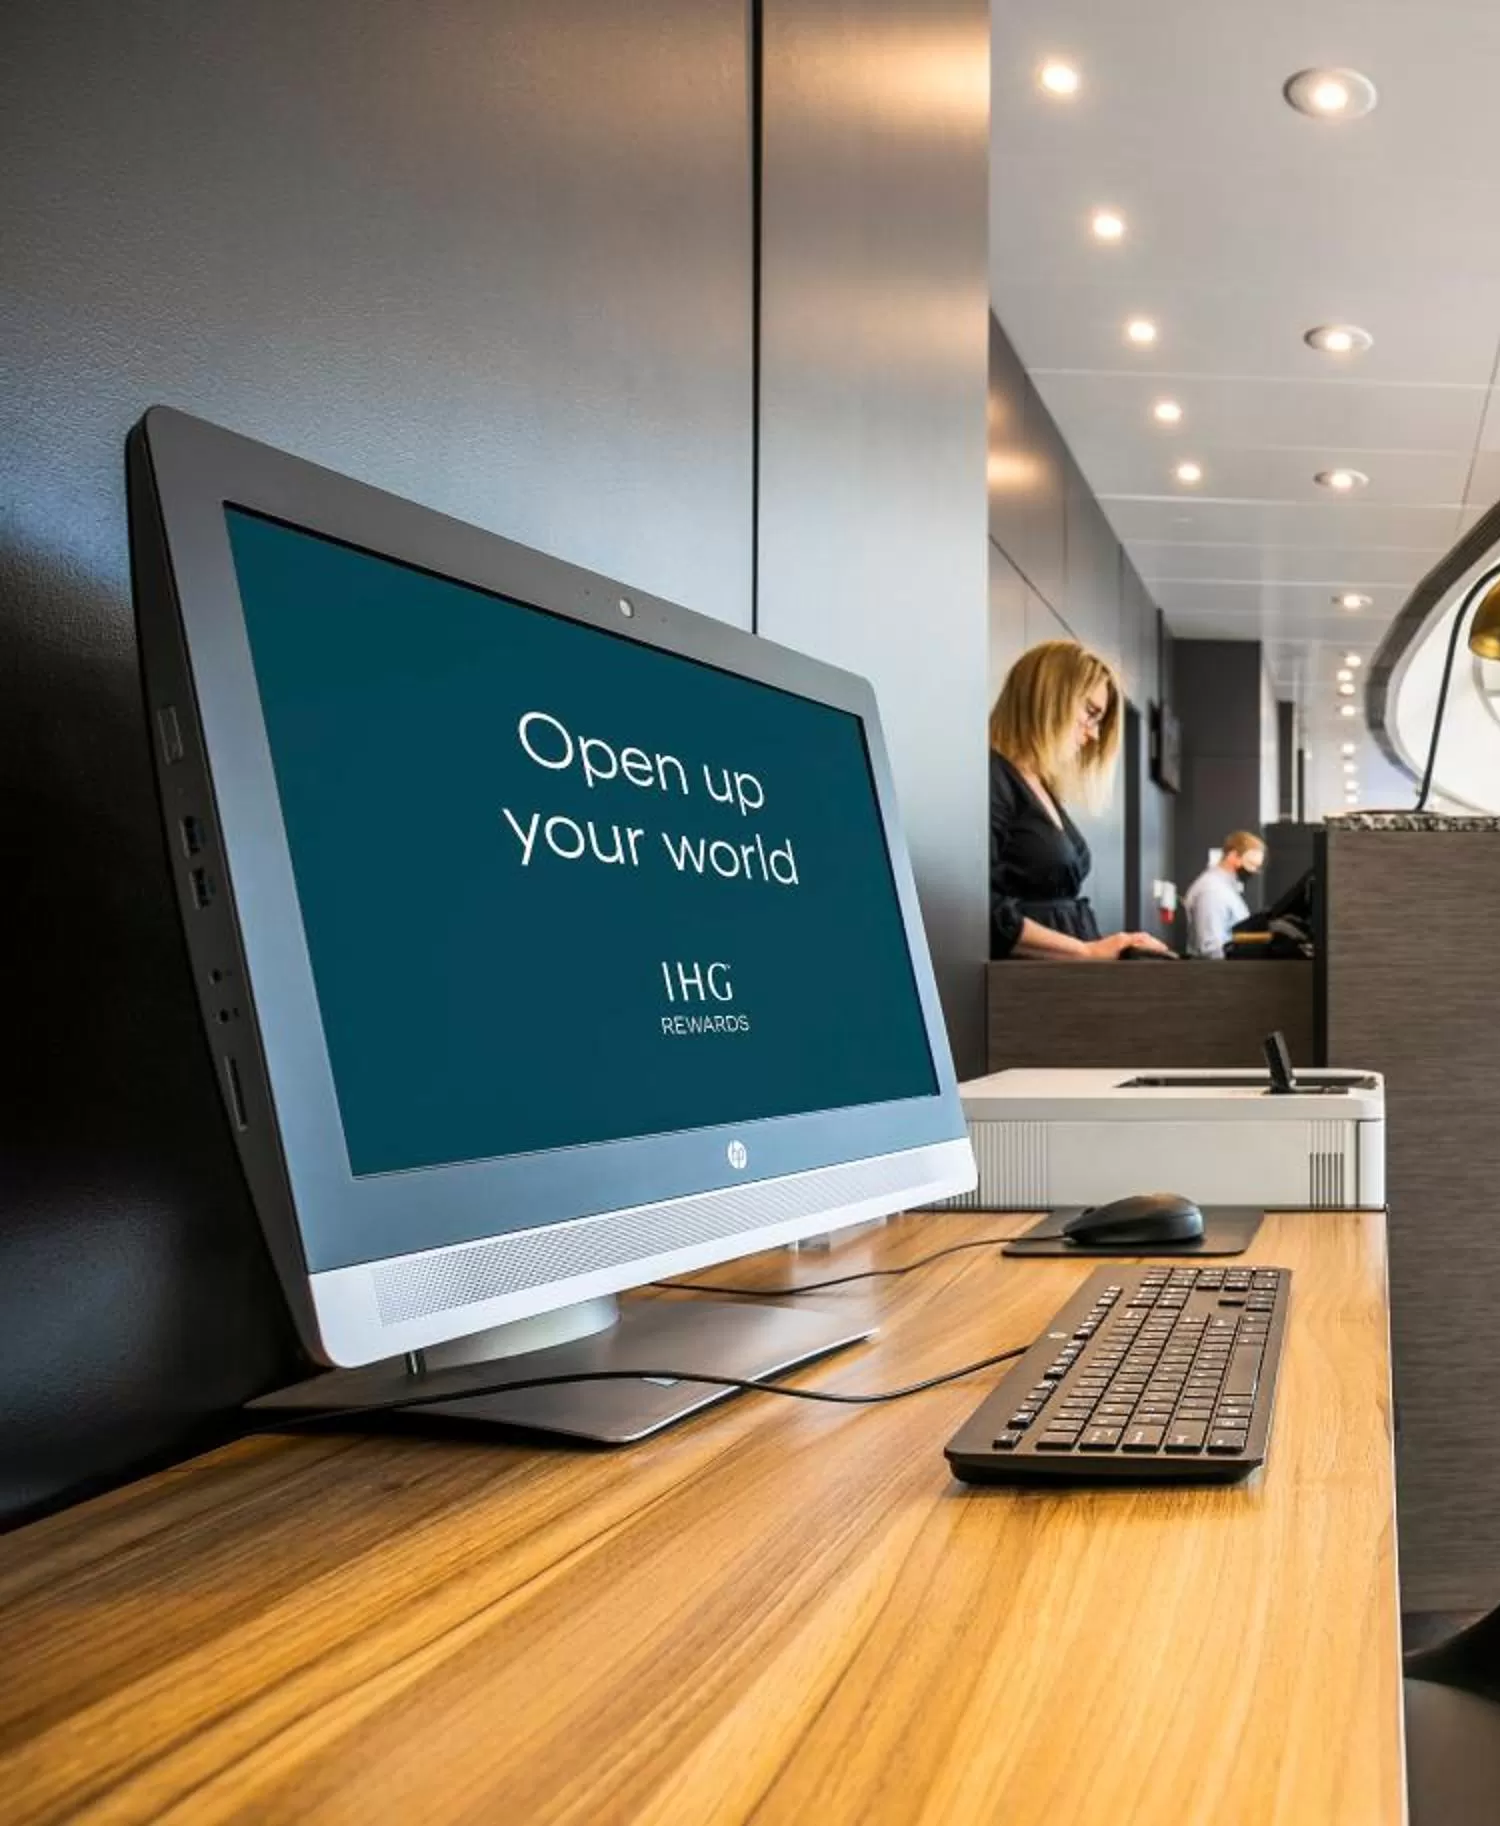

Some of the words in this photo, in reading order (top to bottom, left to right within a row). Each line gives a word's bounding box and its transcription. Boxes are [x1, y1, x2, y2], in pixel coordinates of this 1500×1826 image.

[517, 711, 689, 795] Open
[703, 764, 765, 817] up
[502, 807, 645, 867] your
[661, 832, 800, 886] world
[661, 961, 733, 1002] IHG
[660, 1014, 750, 1035] REWARDS
